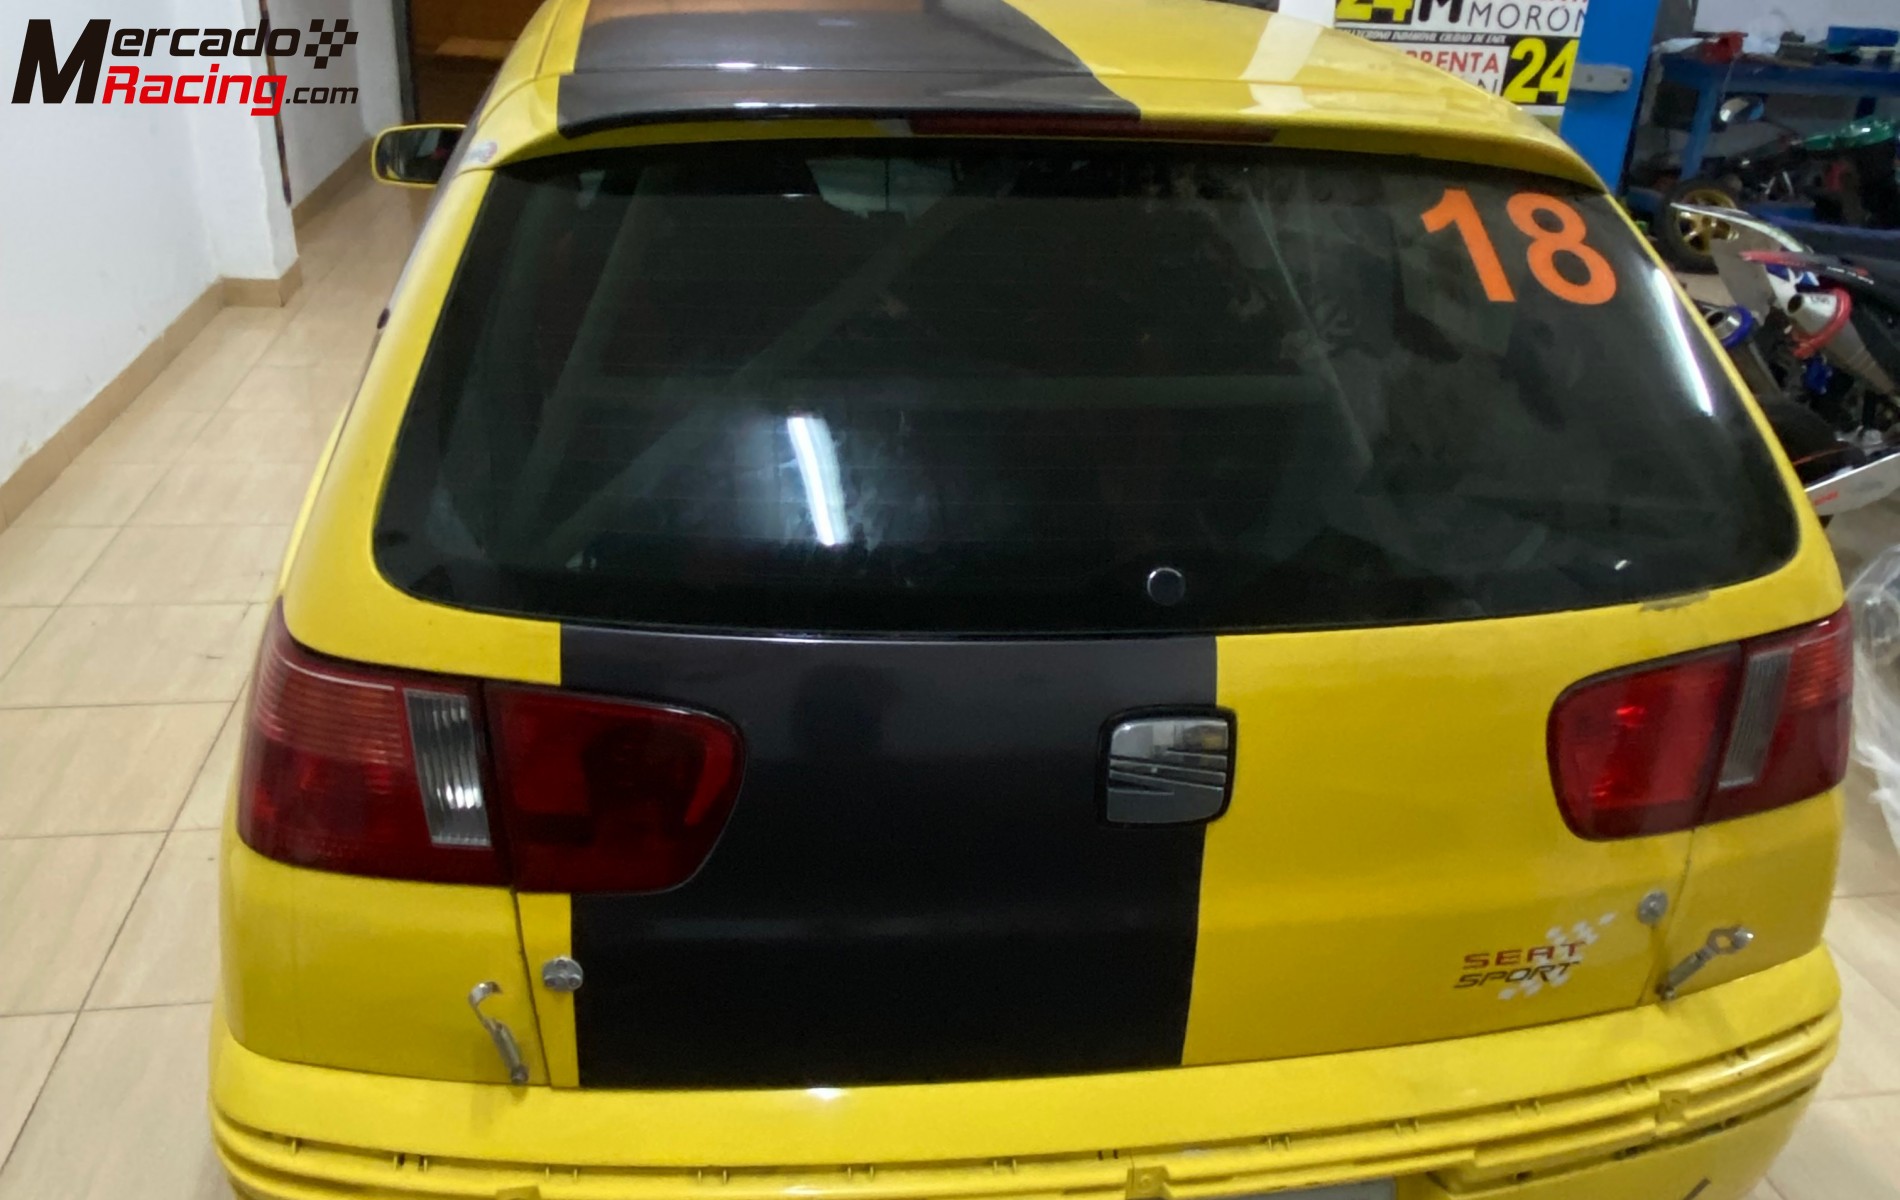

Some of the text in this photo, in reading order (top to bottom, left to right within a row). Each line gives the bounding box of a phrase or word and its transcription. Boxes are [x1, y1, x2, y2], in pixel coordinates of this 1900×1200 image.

[1503, 37, 1580, 104] 24
[1421, 188, 1617, 305] 18
[1453, 961, 1582, 989] SPORT
[1463, 940, 1587, 970] SEAT
